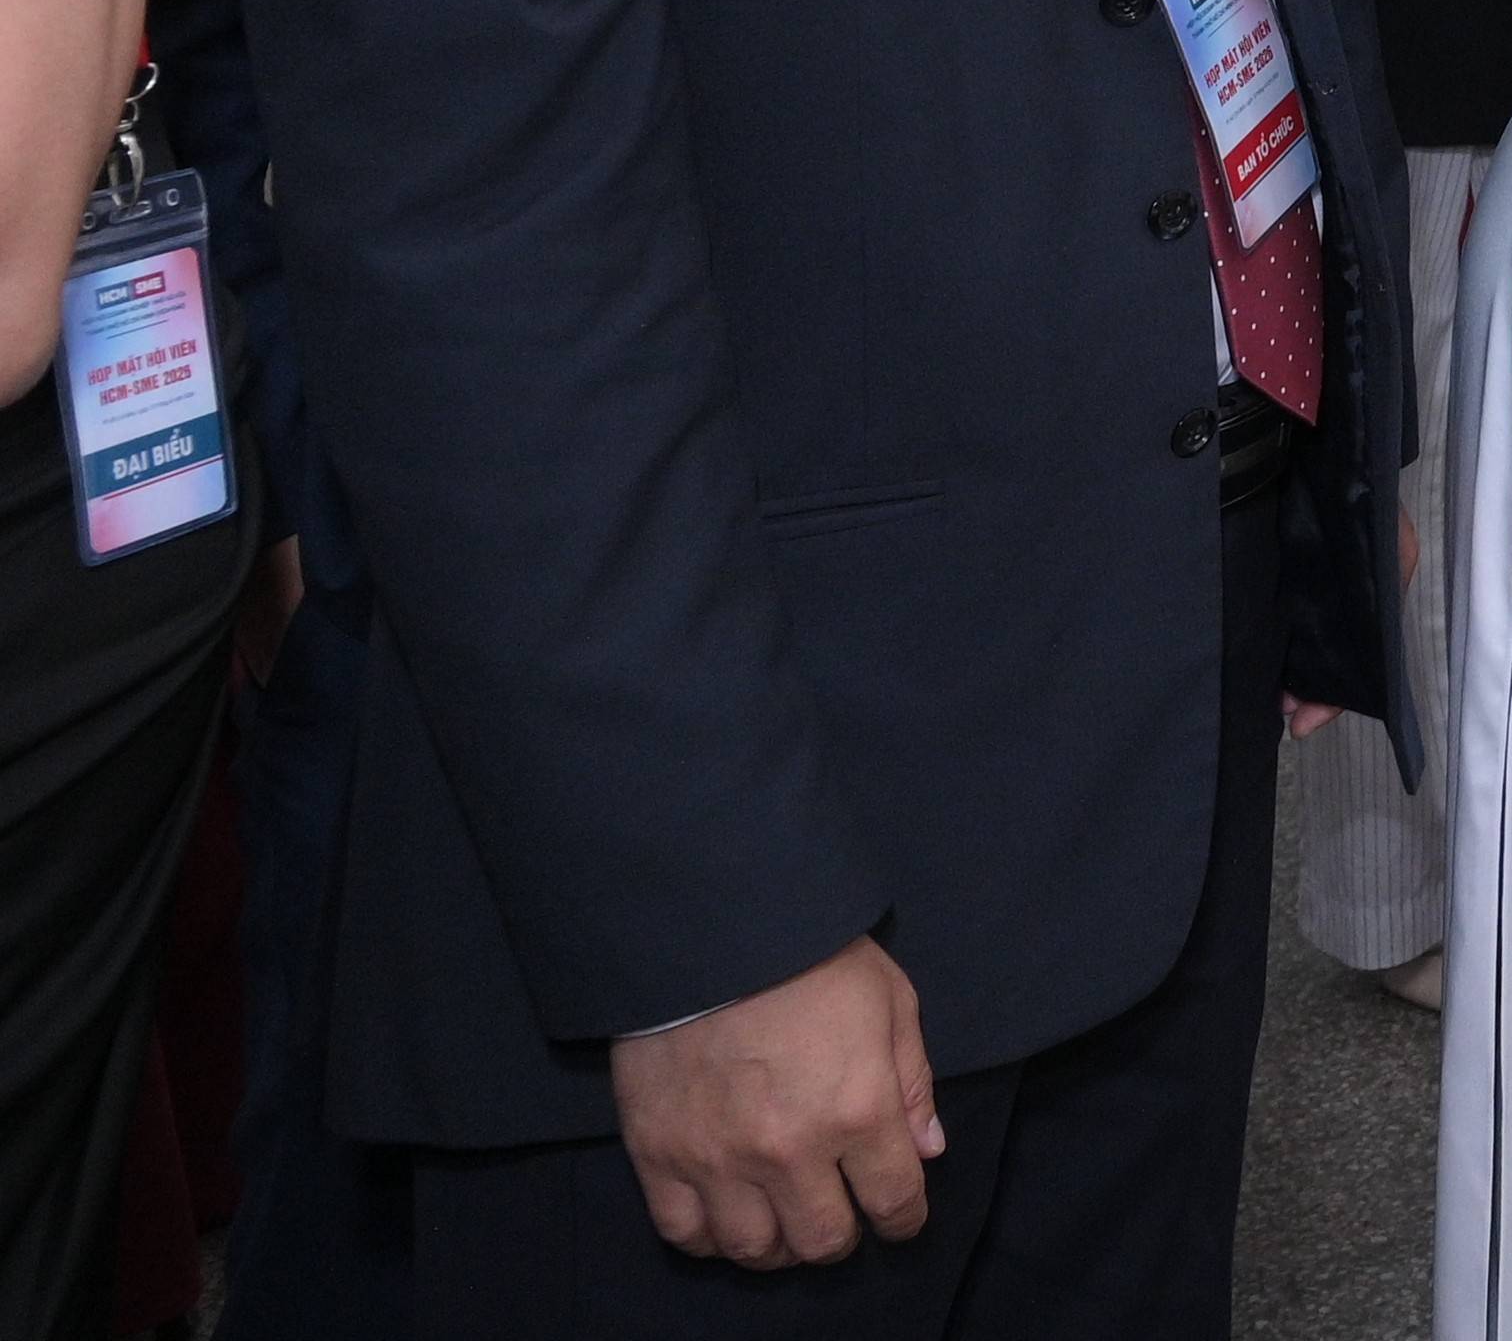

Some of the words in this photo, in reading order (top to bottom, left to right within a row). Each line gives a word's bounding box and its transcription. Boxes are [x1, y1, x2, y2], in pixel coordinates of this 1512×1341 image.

[1237, 153, 1258, 182] BAN
[1256, 132, 1270, 159] TỔ
[1269, 115, 1295, 149] CHỨC
[112, 447, 148, 481] ĐẠI
[152, 427, 194, 467] BIỂU
